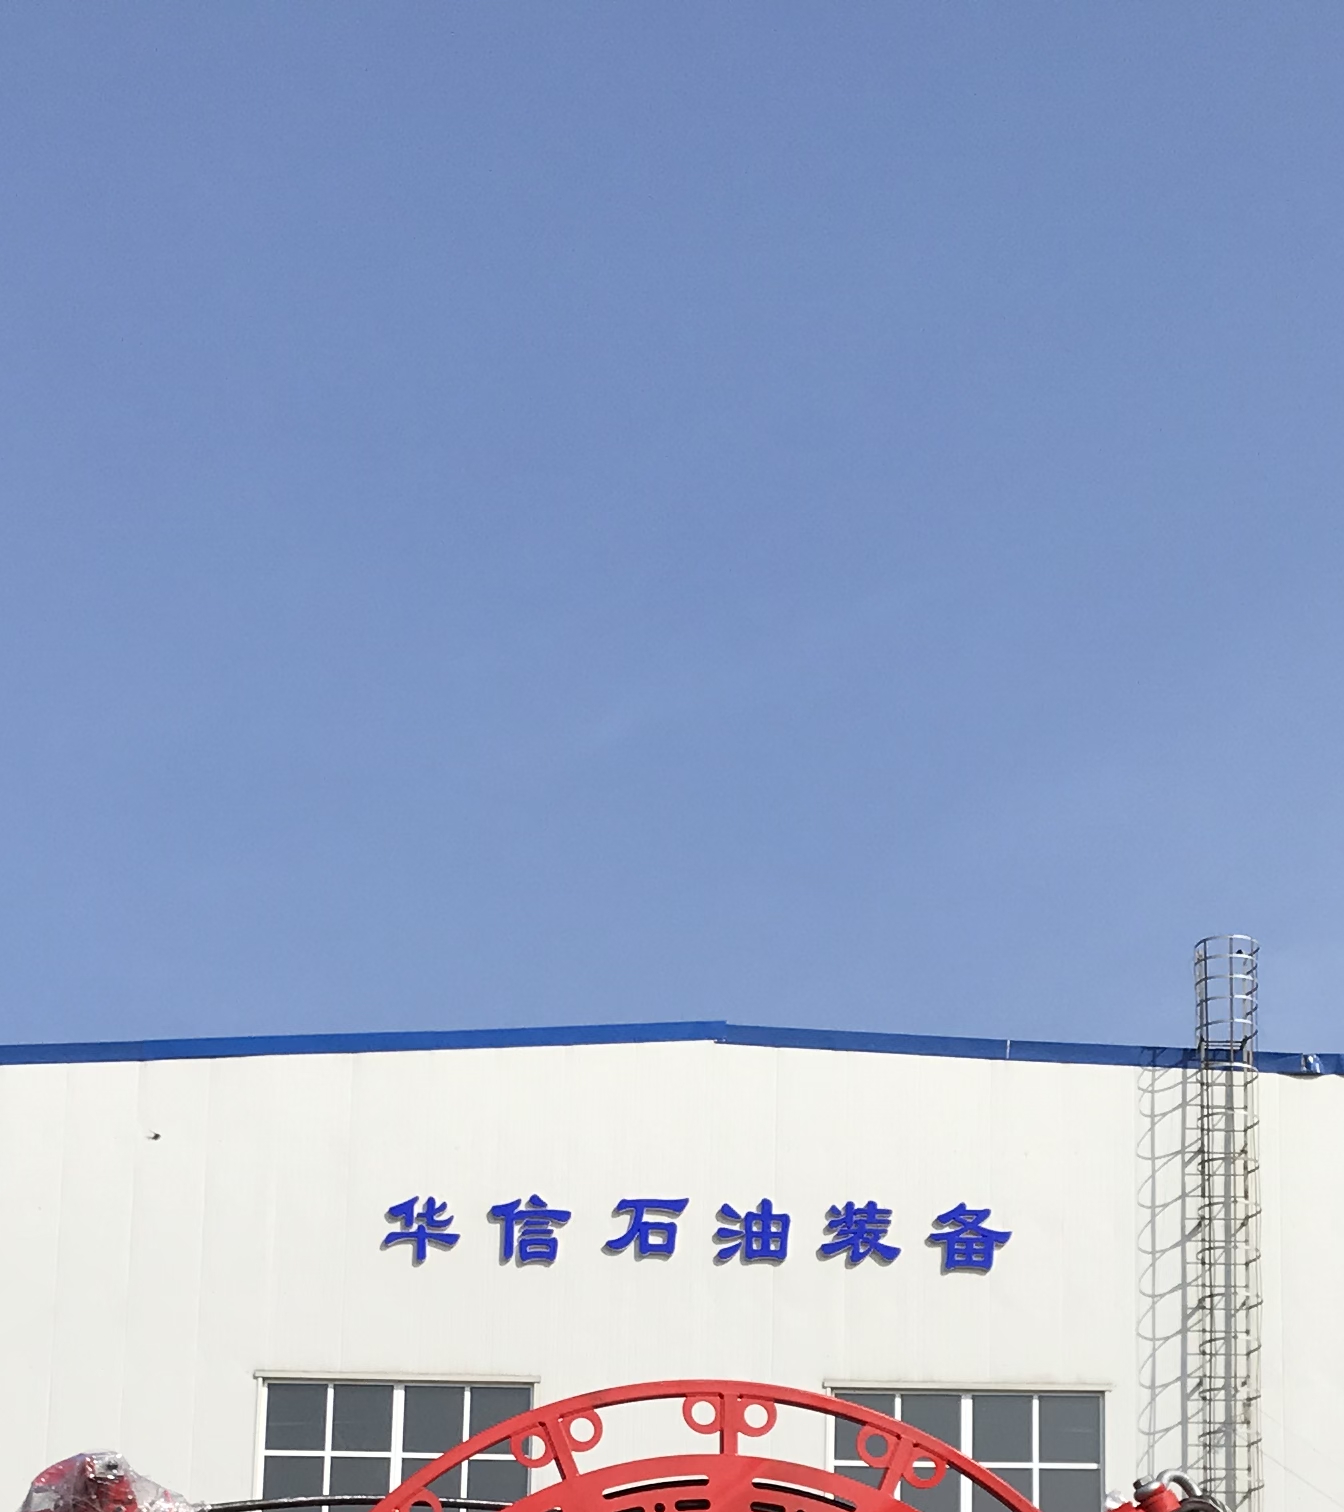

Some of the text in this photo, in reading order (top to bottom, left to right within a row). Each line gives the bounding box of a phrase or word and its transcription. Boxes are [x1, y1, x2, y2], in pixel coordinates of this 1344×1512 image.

[382, 1195, 1012, 1272] 华信石油装备
